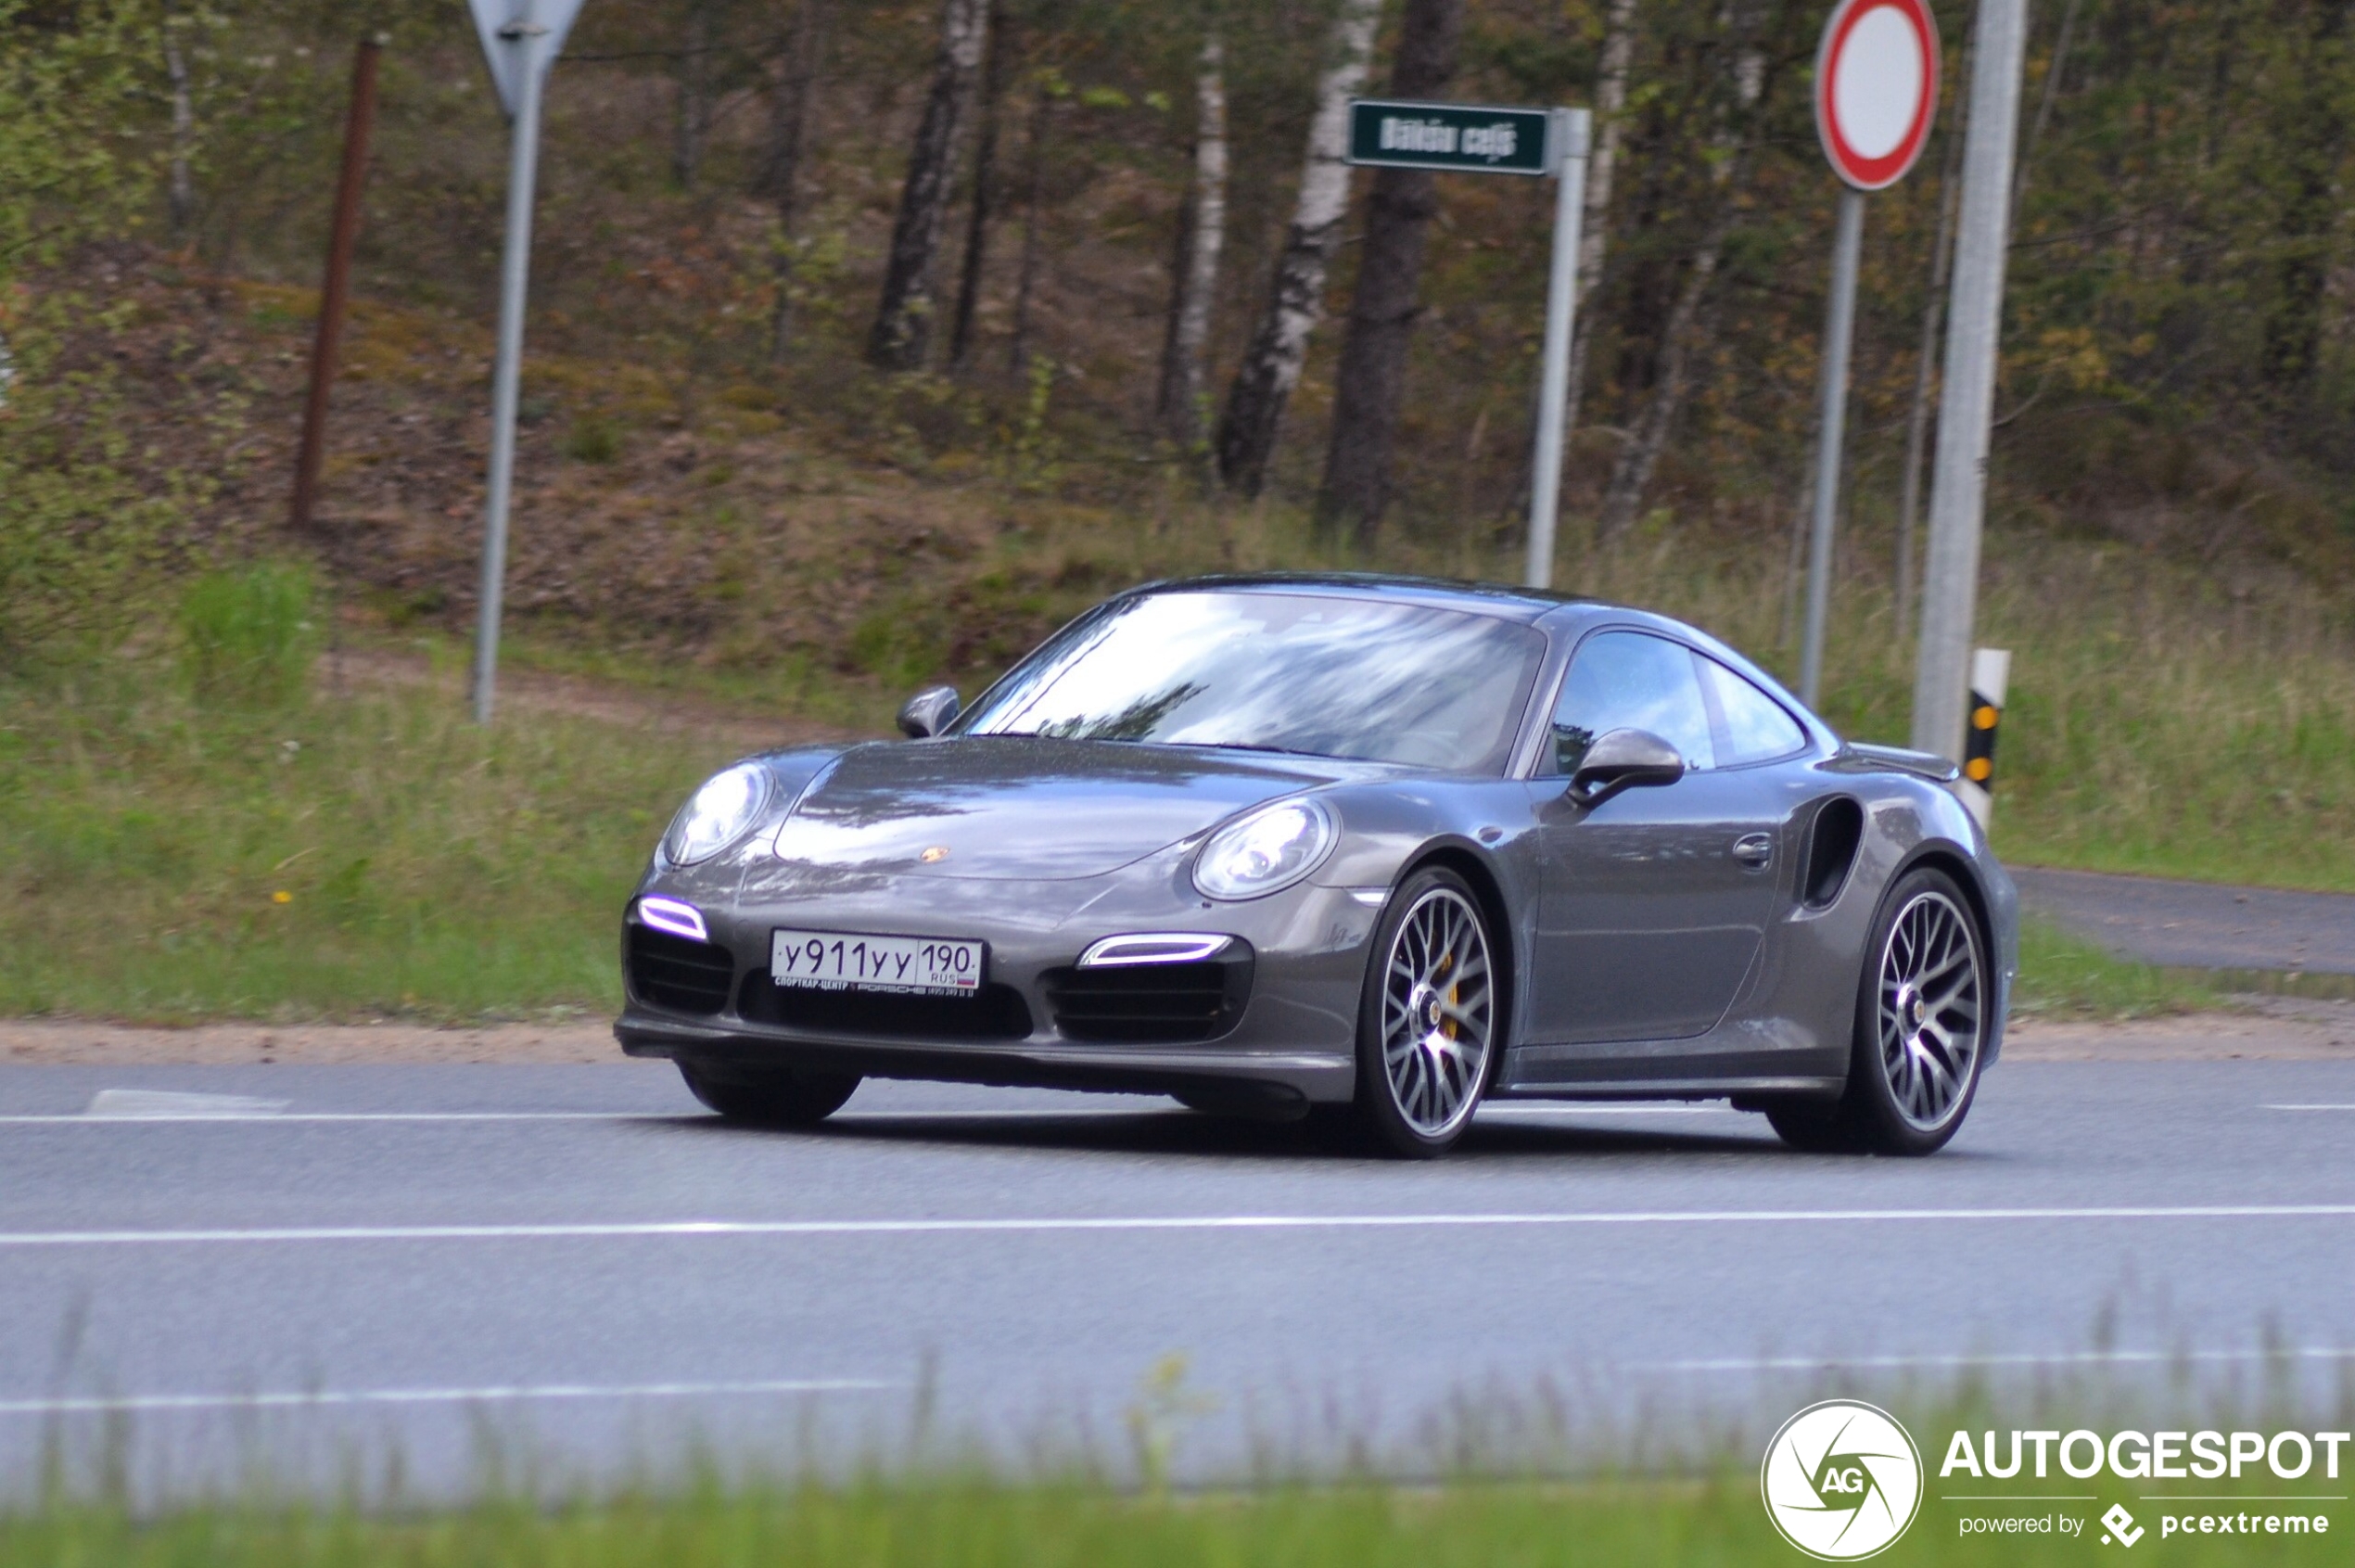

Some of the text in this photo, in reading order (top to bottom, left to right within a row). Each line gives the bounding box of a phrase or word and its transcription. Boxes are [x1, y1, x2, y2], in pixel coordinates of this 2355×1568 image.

[922, 944, 971, 973] 190
[931, 973, 956, 985] RUS
[858, 983, 926, 995] PORSCHE
